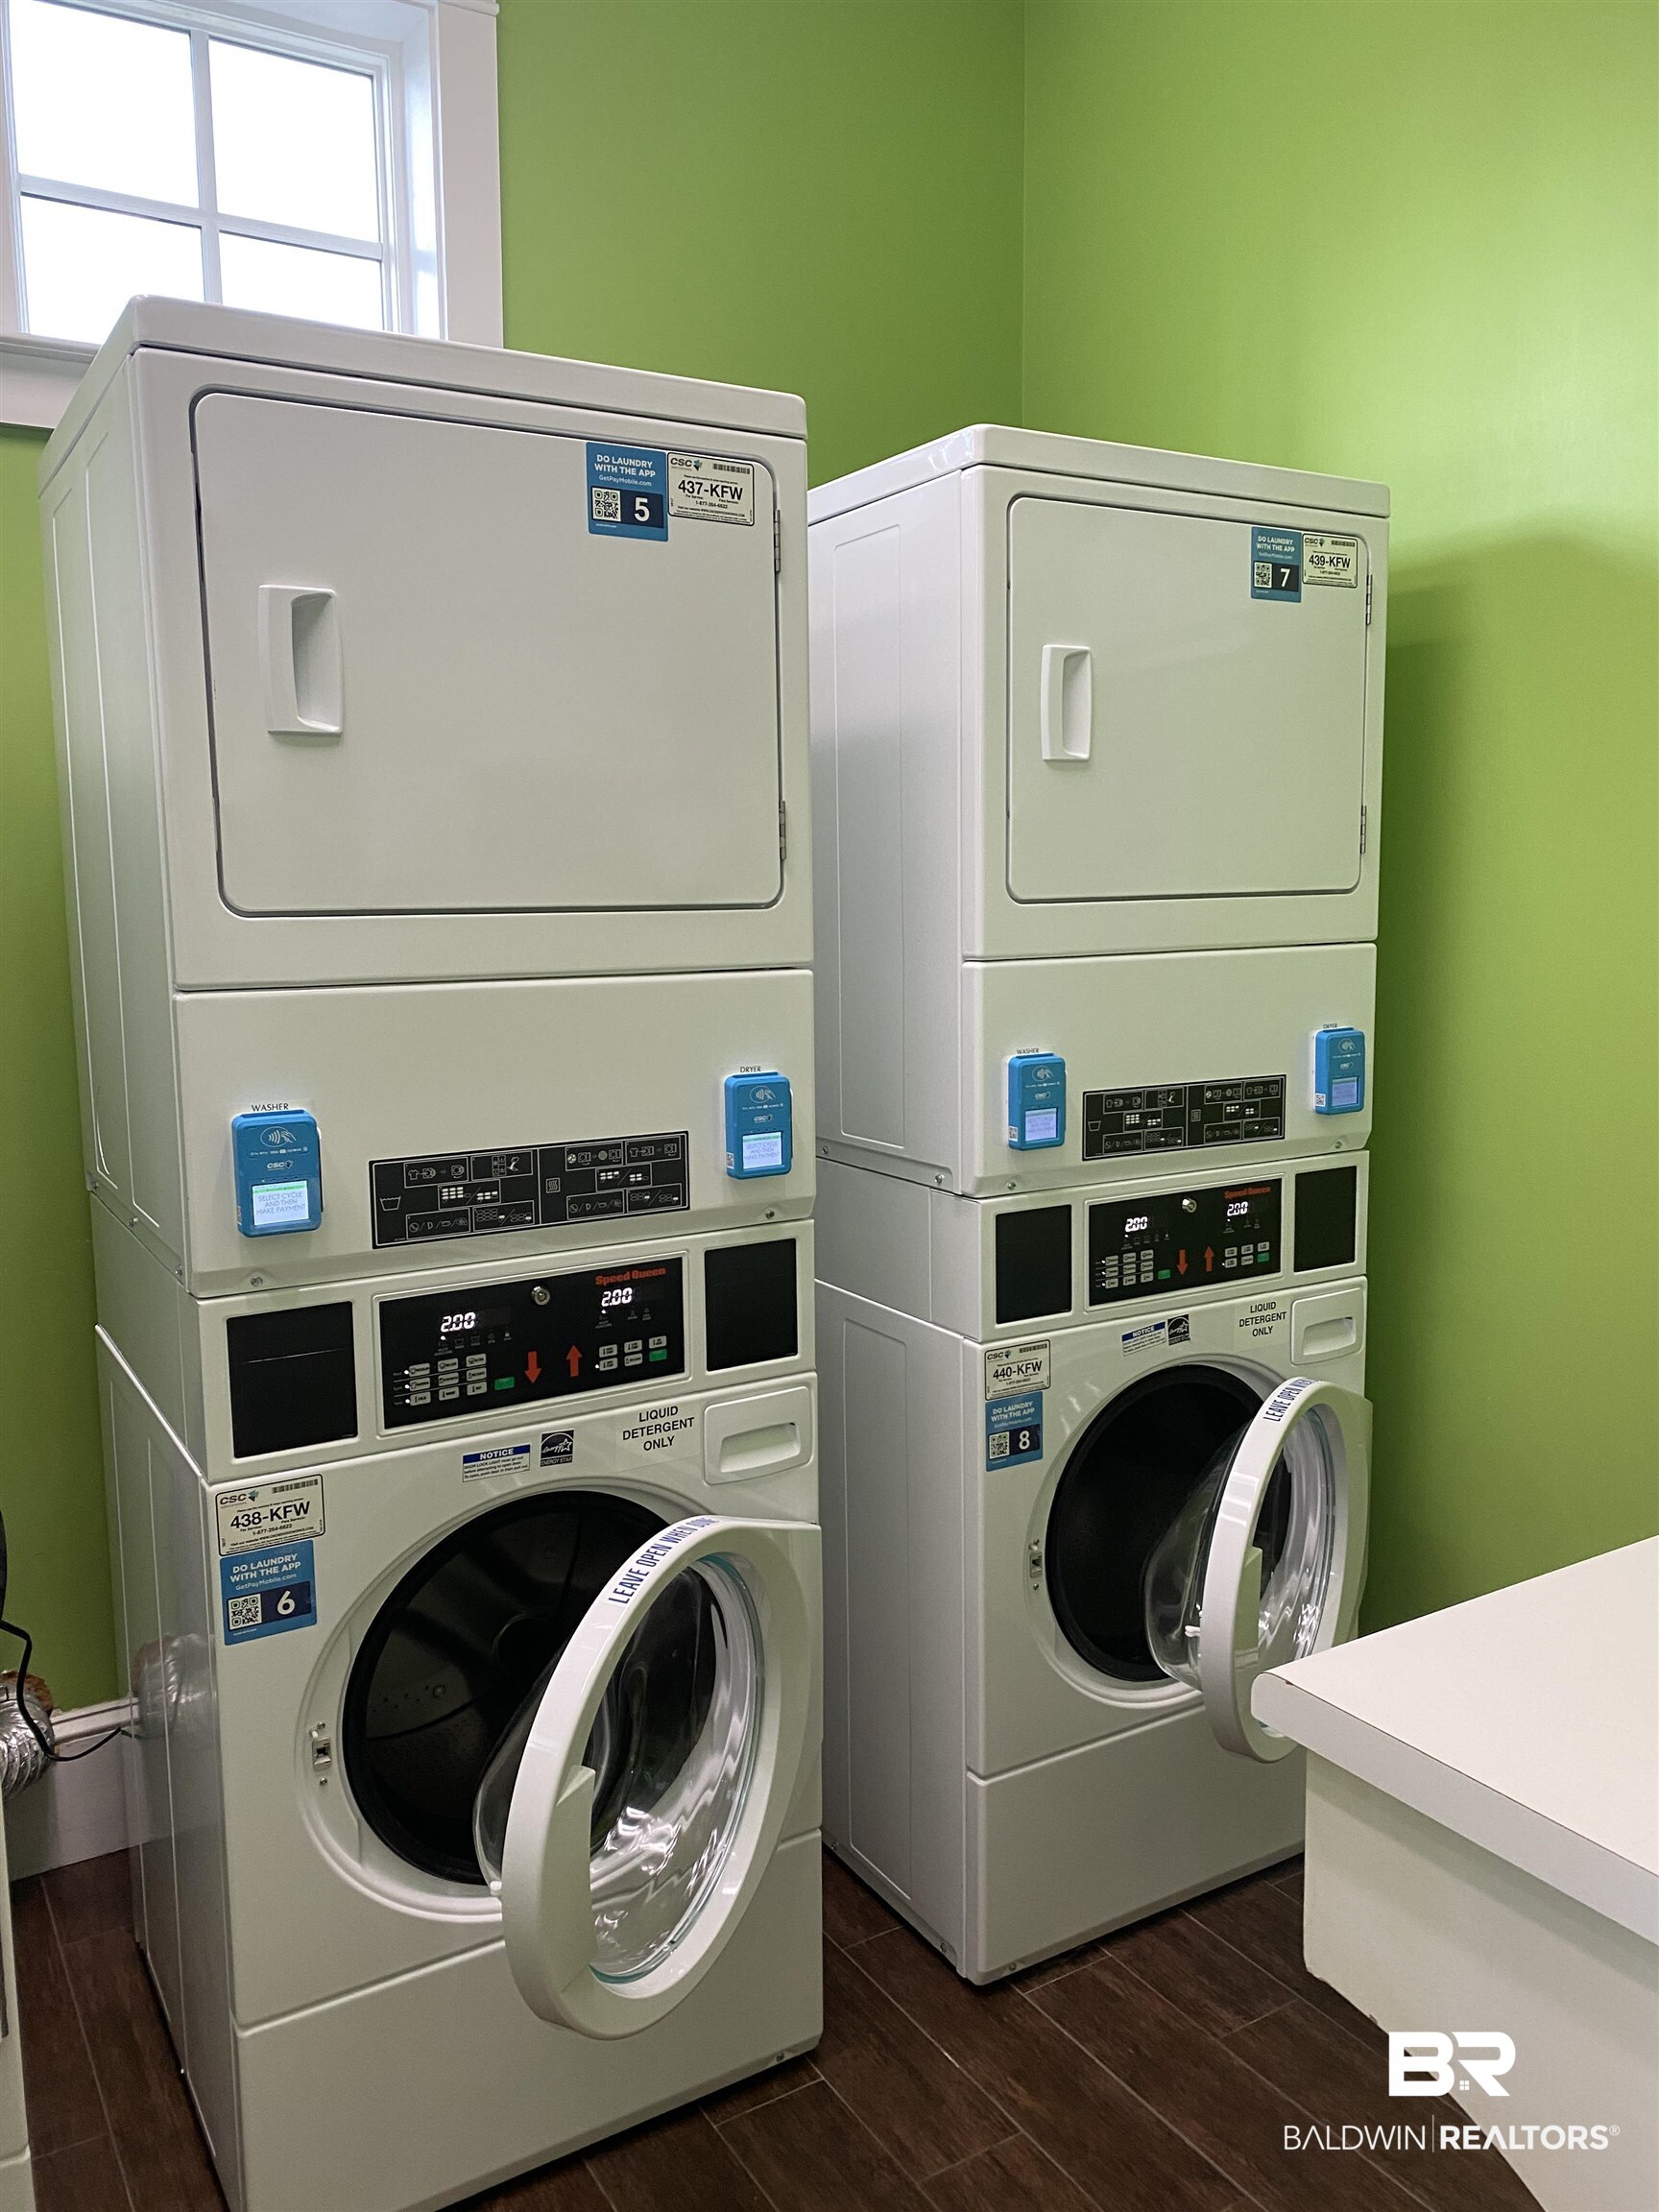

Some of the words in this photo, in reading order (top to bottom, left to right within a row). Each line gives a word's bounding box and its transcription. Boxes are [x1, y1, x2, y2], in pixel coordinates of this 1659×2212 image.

[597, 454, 609, 463] DO
[612, 457, 653, 468] LAUNDRY
[671, 458, 692, 467] CSC
[594, 463, 618, 473] WITH
[621, 466, 637, 475] THE
[639, 468, 656, 478] APP
[599, 475, 652, 486] GetPayMobile.com
[678, 480, 743, 501] 437-KFW
[634, 497, 650, 522] 5
[1309, 554, 1350, 568] 439-KFW
[1280, 568, 1290, 587] 7
[251, 1103, 289, 1111] WASHER
[276, 1204, 306, 1212] PAYMENT
[595, 1271, 630, 1286] Speed
[632, 1268, 666, 1279] Queen
[601, 1287, 632, 1307] 2.00
[1250, 1302, 1276, 1313] LIQUID
[441, 1312, 475, 1332] 2.00
[1239, 1311, 1287, 1327] DETERGENT
[1132, 1326, 1155, 1337] NOTICE
[1252, 1326, 1273, 1337] ONLY
[987, 1352, 1004, 1360] CSC
[993, 1360, 1042, 1379] 440-KFW
[639, 1406, 678, 1422] LIQUID
[1004, 1401, 1033, 1412] LAUNDRY
[1263, 1400, 1291, 1421] LEAVE
[991, 1414, 1008, 1422] WITH
[623, 1417, 694, 1440] DETERGENT
[643, 1436, 675, 1451] ONLY
[1019, 1430, 1030, 1449] 8
[480, 1448, 514, 1460] NOTICE
[220, 1493, 246, 1505] CSC
[231, 1501, 310, 1529] 438-KFW
[230, 1572, 257, 1582] WITH
[259, 1567, 279, 1577] THE
[282, 1561, 301, 1573] APP
[233, 1564, 248, 1574] DO
[250, 1553, 297, 1570] LAUNDRY
[608, 1568, 649, 1604] LEAVE
[636, 1543, 673, 1567] OPEN
[659, 1525, 698, 1544] WHEN
[236, 1573, 296, 1590] GetPayMobile.com
[277, 1590, 295, 1615] 6
